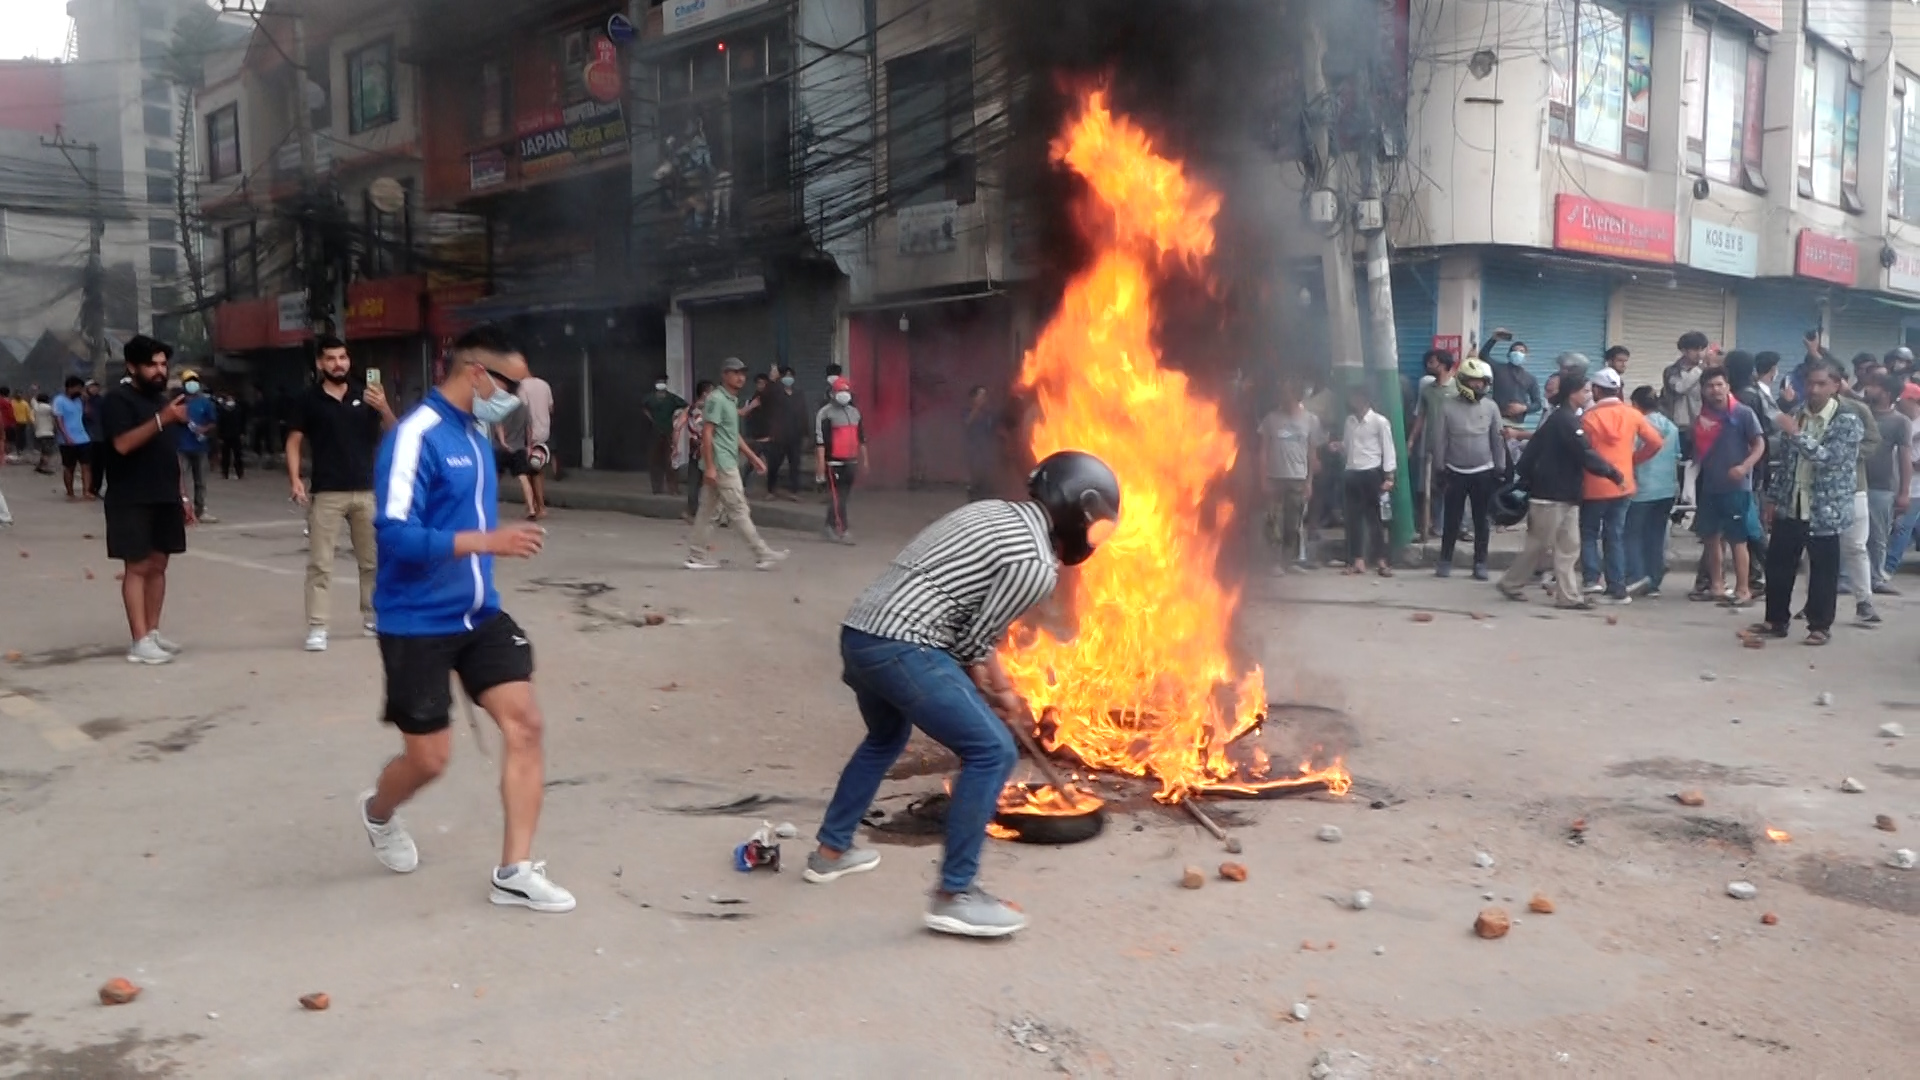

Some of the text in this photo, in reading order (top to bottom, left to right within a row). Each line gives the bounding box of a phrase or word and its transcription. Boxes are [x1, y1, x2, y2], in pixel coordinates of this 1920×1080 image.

[520, 129, 568, 156] JAPAN
[1582, 206, 1626, 234] Everest
[1705, 228, 1723, 247] KOS
